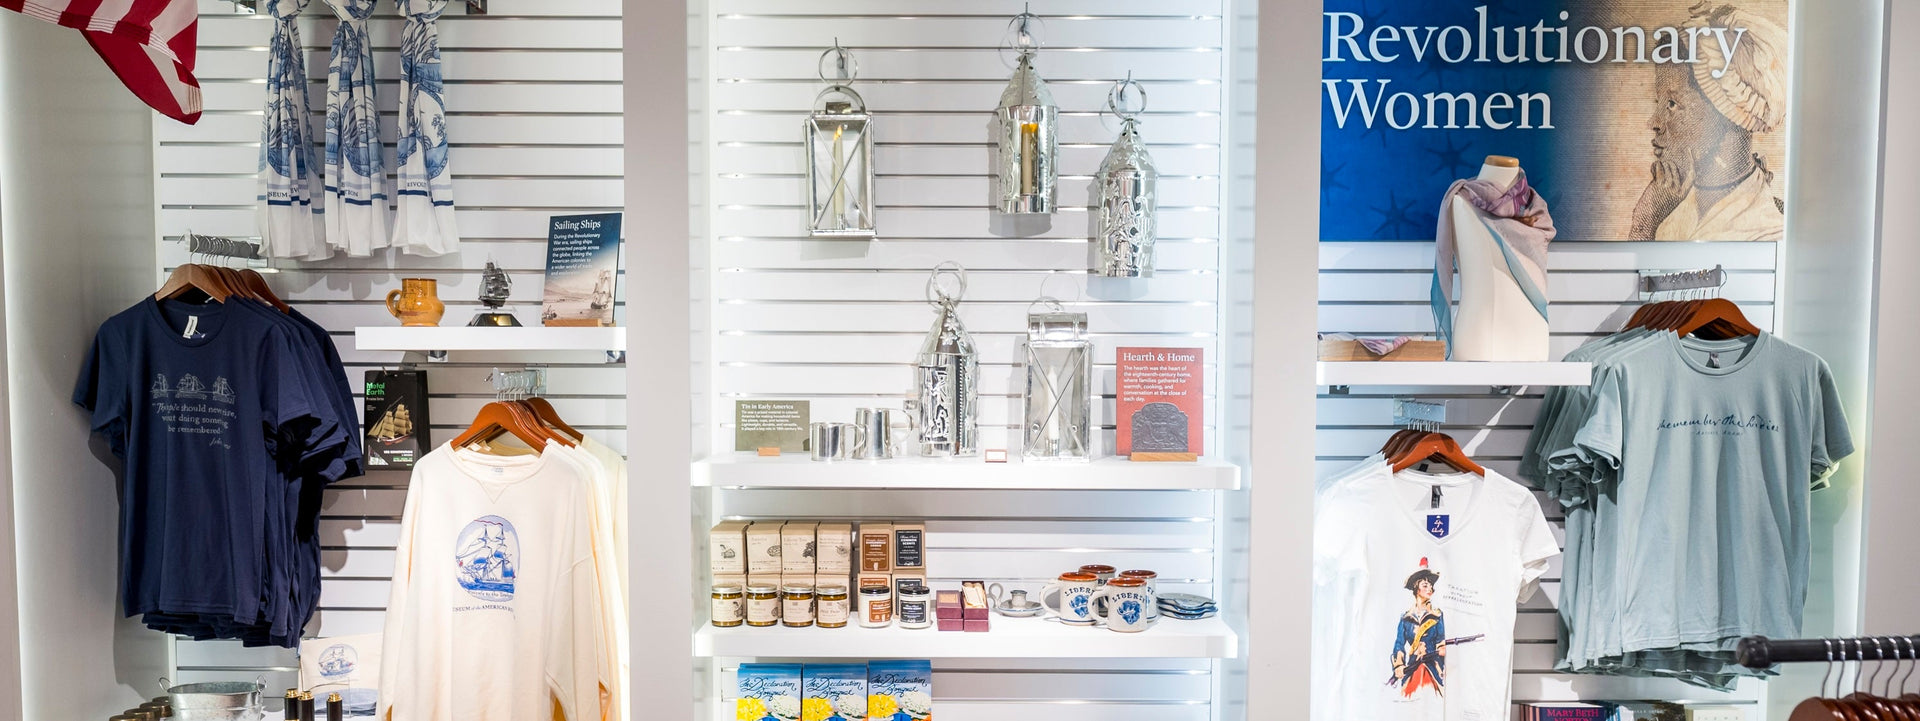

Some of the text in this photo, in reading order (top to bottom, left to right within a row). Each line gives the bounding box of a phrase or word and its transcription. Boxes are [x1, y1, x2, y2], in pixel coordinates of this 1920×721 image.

[1322, 5, 1747, 79] Revolutionary
[1322, 78, 1555, 130] Women
[554, 219, 601, 231] Sailing Ships
[574, 232, 600, 240] Revolutionary
[1123, 352, 1196, 362] Hearth & Home
[366, 382, 385, 390] Metal
[180, 404, 207, 413] should
[178, 414, 201, 425] doing
[749, 677, 797, 691] Declaration
[815, 677, 863, 691] Declaration
[880, 674, 928, 688] Declaration
[1546, 708, 1599, 717] MARY BETH
